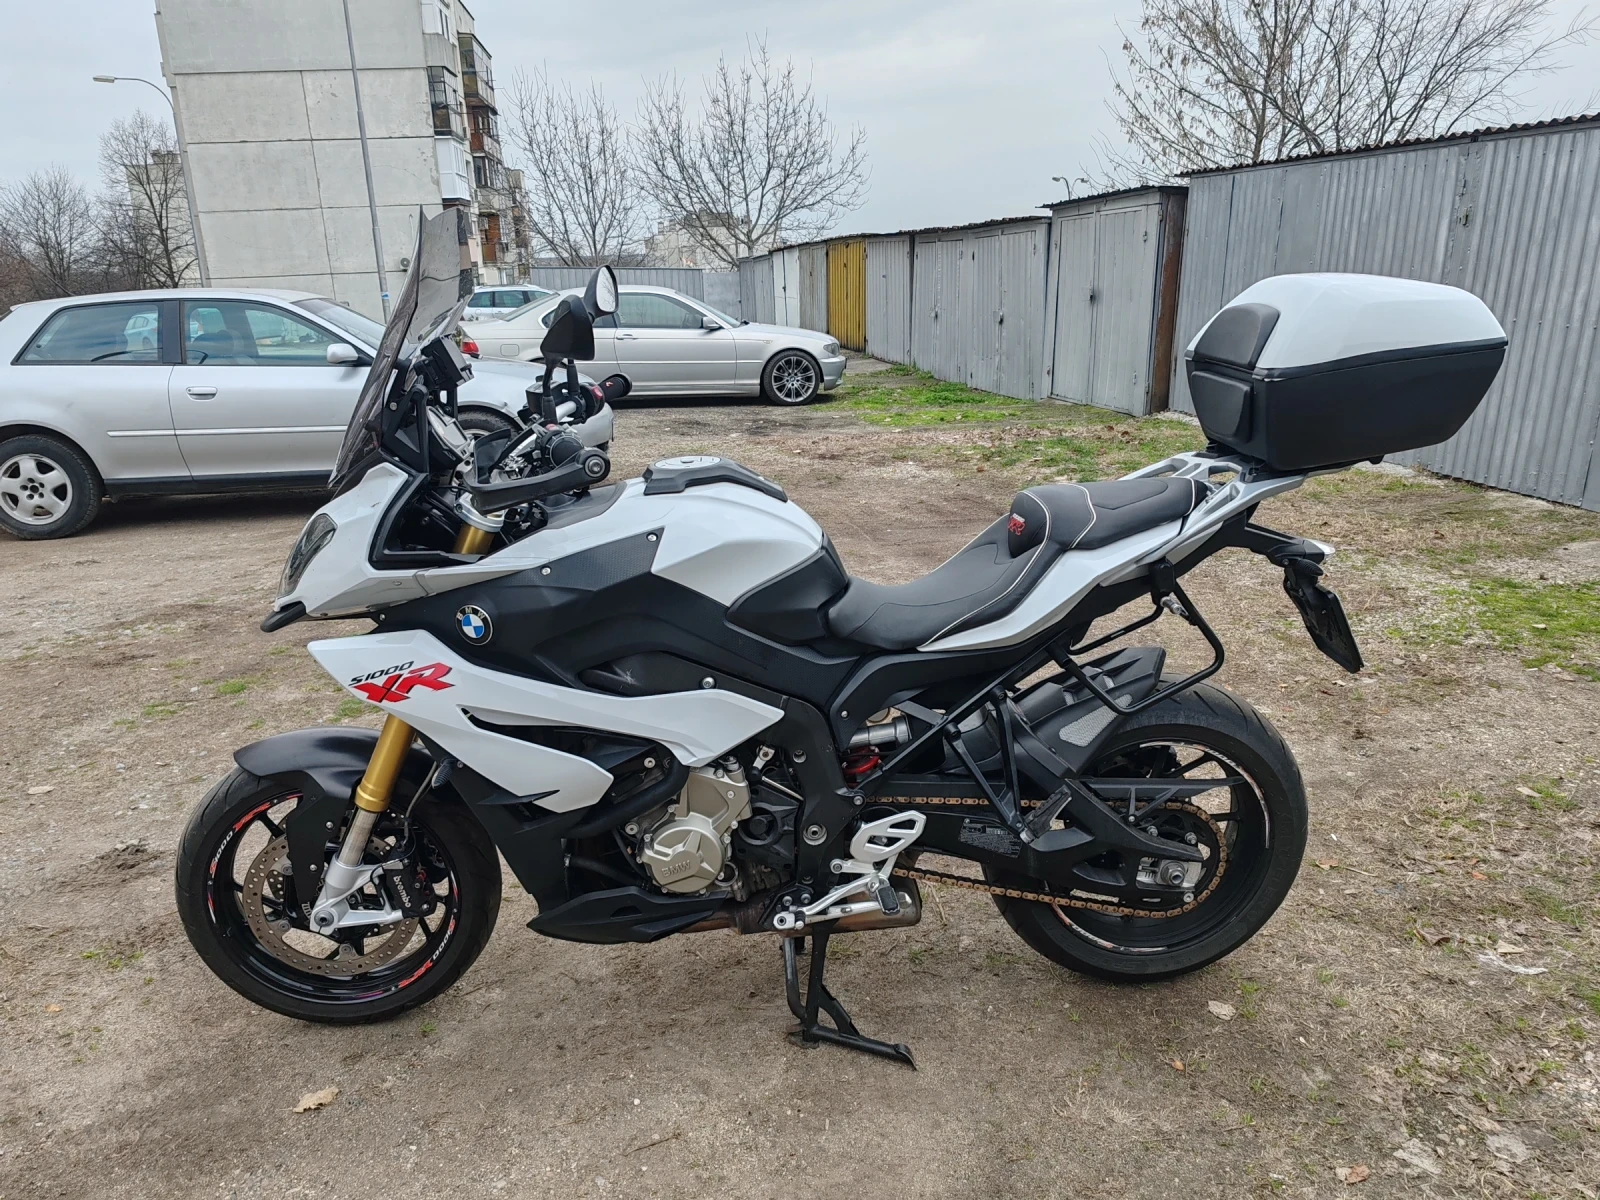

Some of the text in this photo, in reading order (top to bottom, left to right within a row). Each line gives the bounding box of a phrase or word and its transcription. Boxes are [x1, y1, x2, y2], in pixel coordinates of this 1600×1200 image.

[456, 606, 486, 621] BMW
[348, 660, 415, 687] S1000
[353, 662, 456, 703] XR
[661, 859, 691, 877] BMW
[393, 875, 412, 908] brembo
